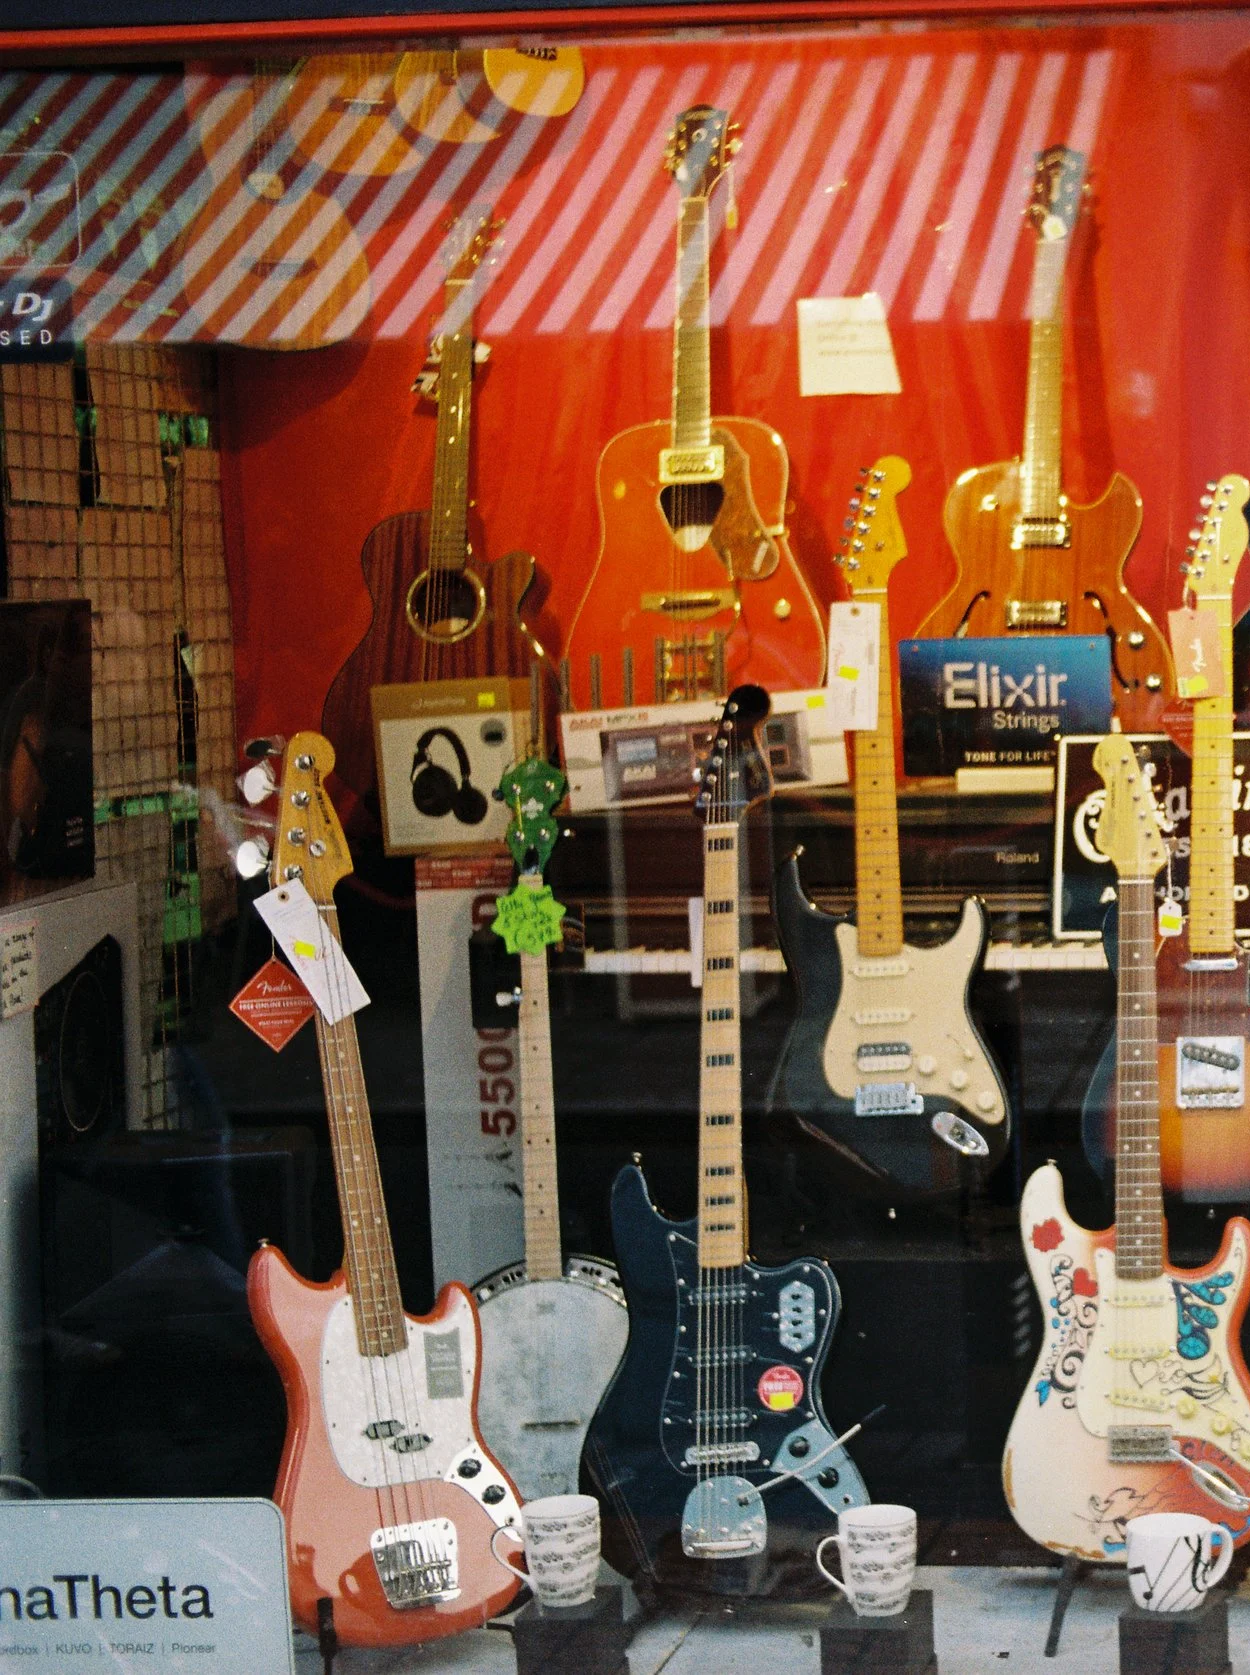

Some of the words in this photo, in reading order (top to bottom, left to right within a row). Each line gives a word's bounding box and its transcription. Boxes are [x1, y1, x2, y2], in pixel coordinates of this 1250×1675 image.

[943, 662, 1068, 709] Elixir
[992, 711, 1060, 734] Strings
[965, 751, 996, 763] TONE
[1000, 751, 1022, 762] FOR
[996, 851, 1041, 864] Roland
[55, 1643, 93, 1655] KUVO
[110, 1643, 156, 1655] TORAIZ
[171, 1643, 216, 1654] Pioneer
